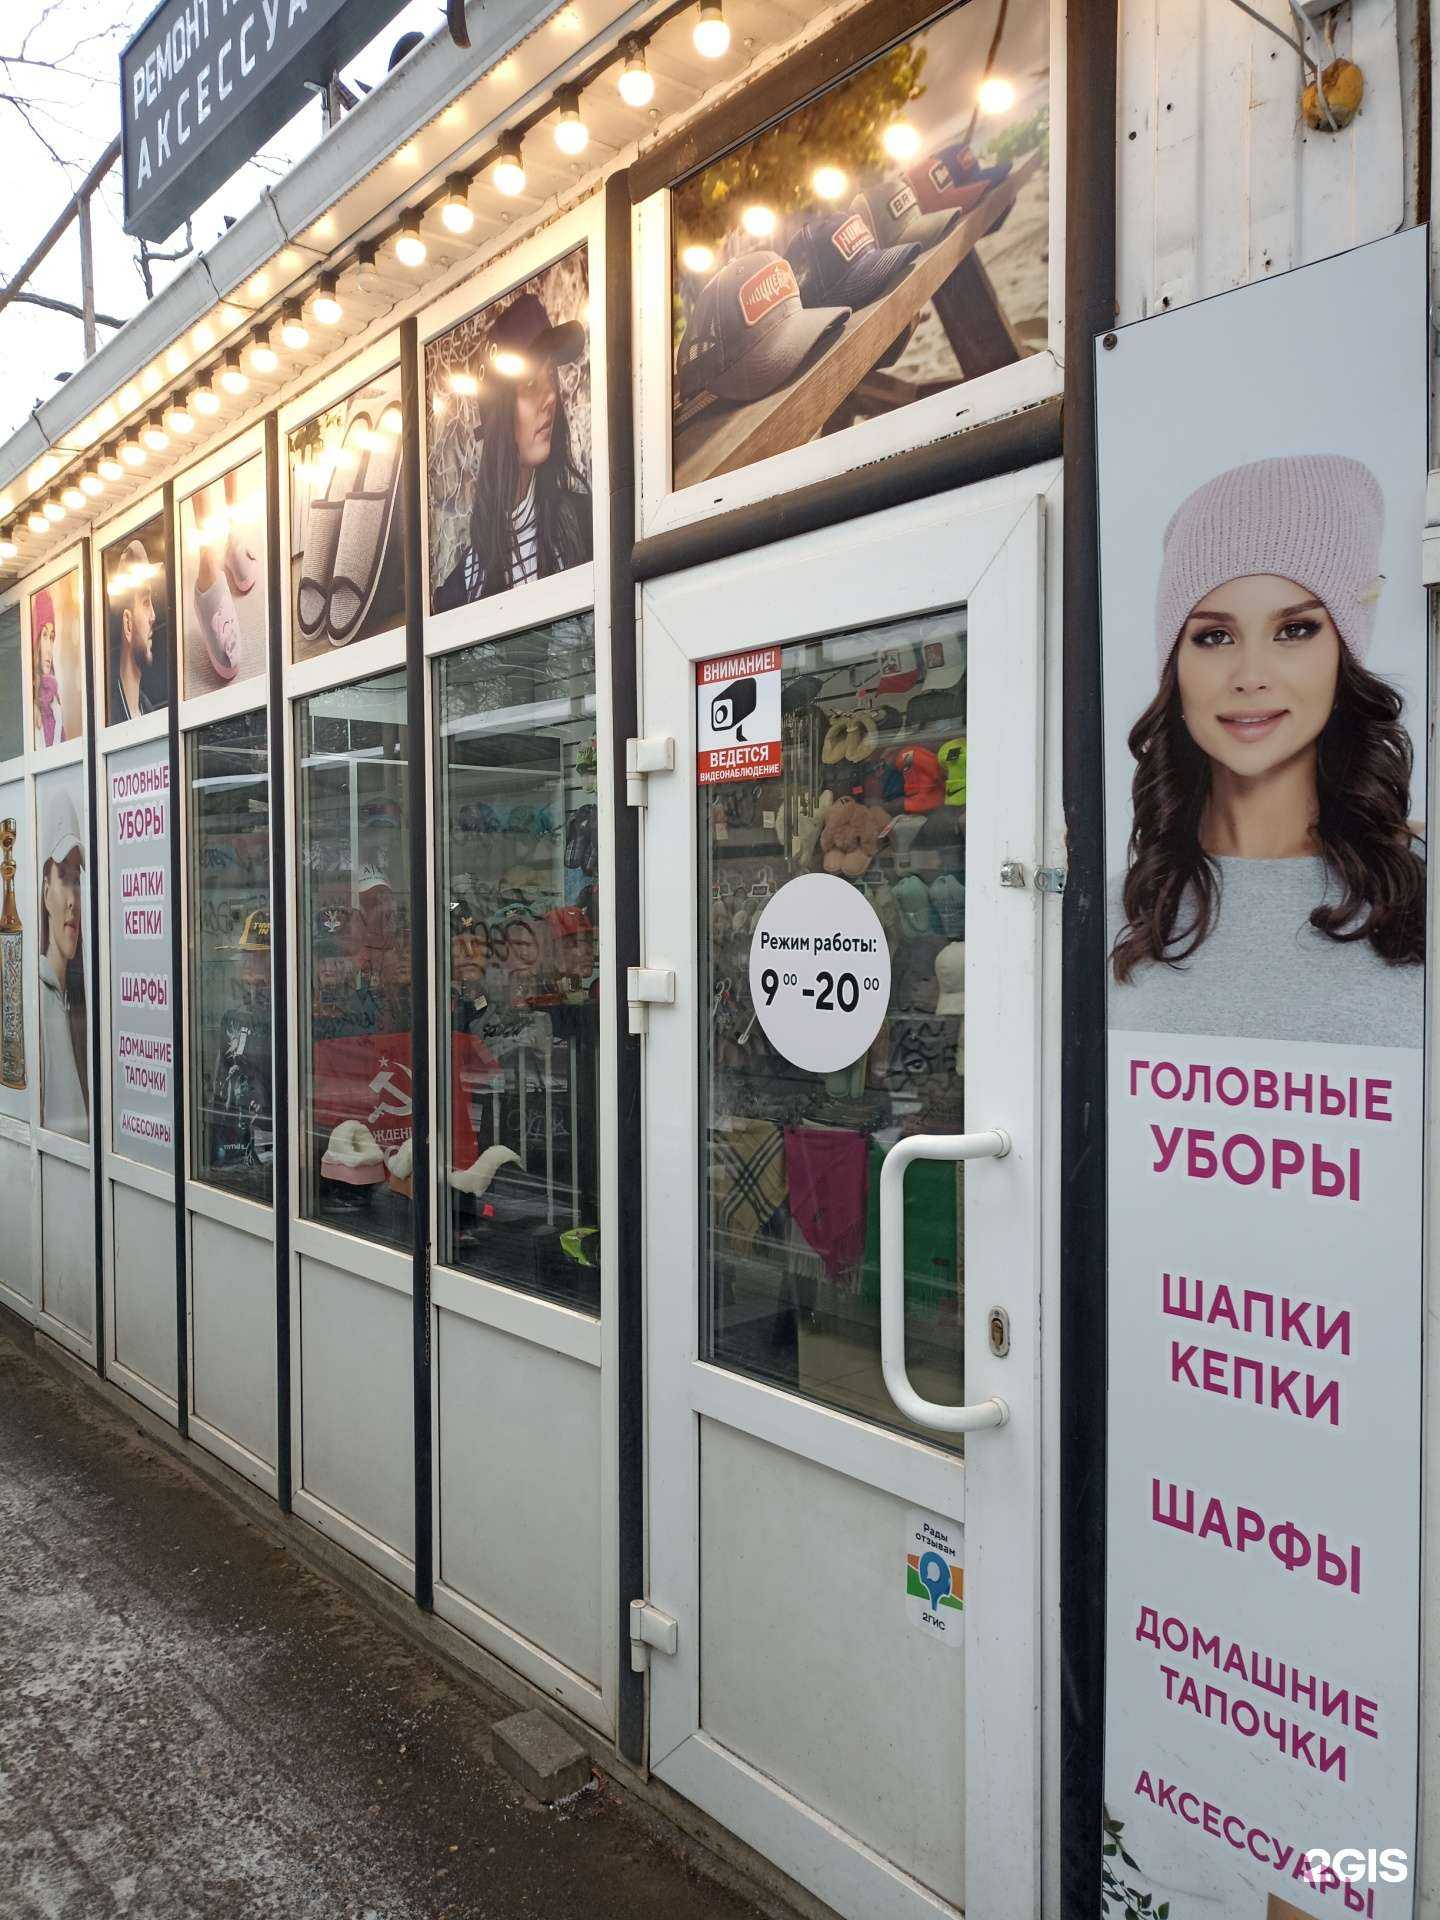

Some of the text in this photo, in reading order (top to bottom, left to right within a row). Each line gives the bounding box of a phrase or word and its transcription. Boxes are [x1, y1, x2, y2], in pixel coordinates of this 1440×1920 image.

[703, 651, 775, 681] ВНИМАНИЕ!
[710, 745, 769, 768] ВЕДЕТСЯ
[113, 765, 169, 799] ГОЛОВНЫЕ
[700, 763, 780, 782] ВИДЕОНАБЛЮДЕНИЕ
[118, 805, 164, 840] УБОРЫ
[122, 870, 164, 897] ШАПКИ
[125, 910, 162, 934] КЕПКИ
[761, 931, 877, 956] Режим работы:
[121, 977, 168, 1006] ШАРФЫ
[119, 1036, 172, 1063] ДОМАШНИЕ
[125, 1065, 166, 1092] ТАПОЧКИ
[1130, 1059, 1393, 1122] ГОЛОВНЫЕ
[122, 1113, 171, 1143] АКСЕССУАРЫ
[1150, 1124, 1361, 1202] УБОРЫ
[1162, 1273, 1351, 1356] ШАПКИ
[1171, 1341, 1340, 1426] КЕПКИ
[915, 1533, 956, 1557] отзывам
[923, 1523, 948, 1542] Рады
[1152, 1478, 1361, 1594] ШАРФЫ
[922, 1612, 946, 1631] 2ГИС
[1136, 1606, 1378, 1739] ДОМАШНИЕ
[1160, 1664, 1347, 1782] ТАПОЧКИ
[1134, 1769, 1374, 1919] АКСЕССУАРЫ
